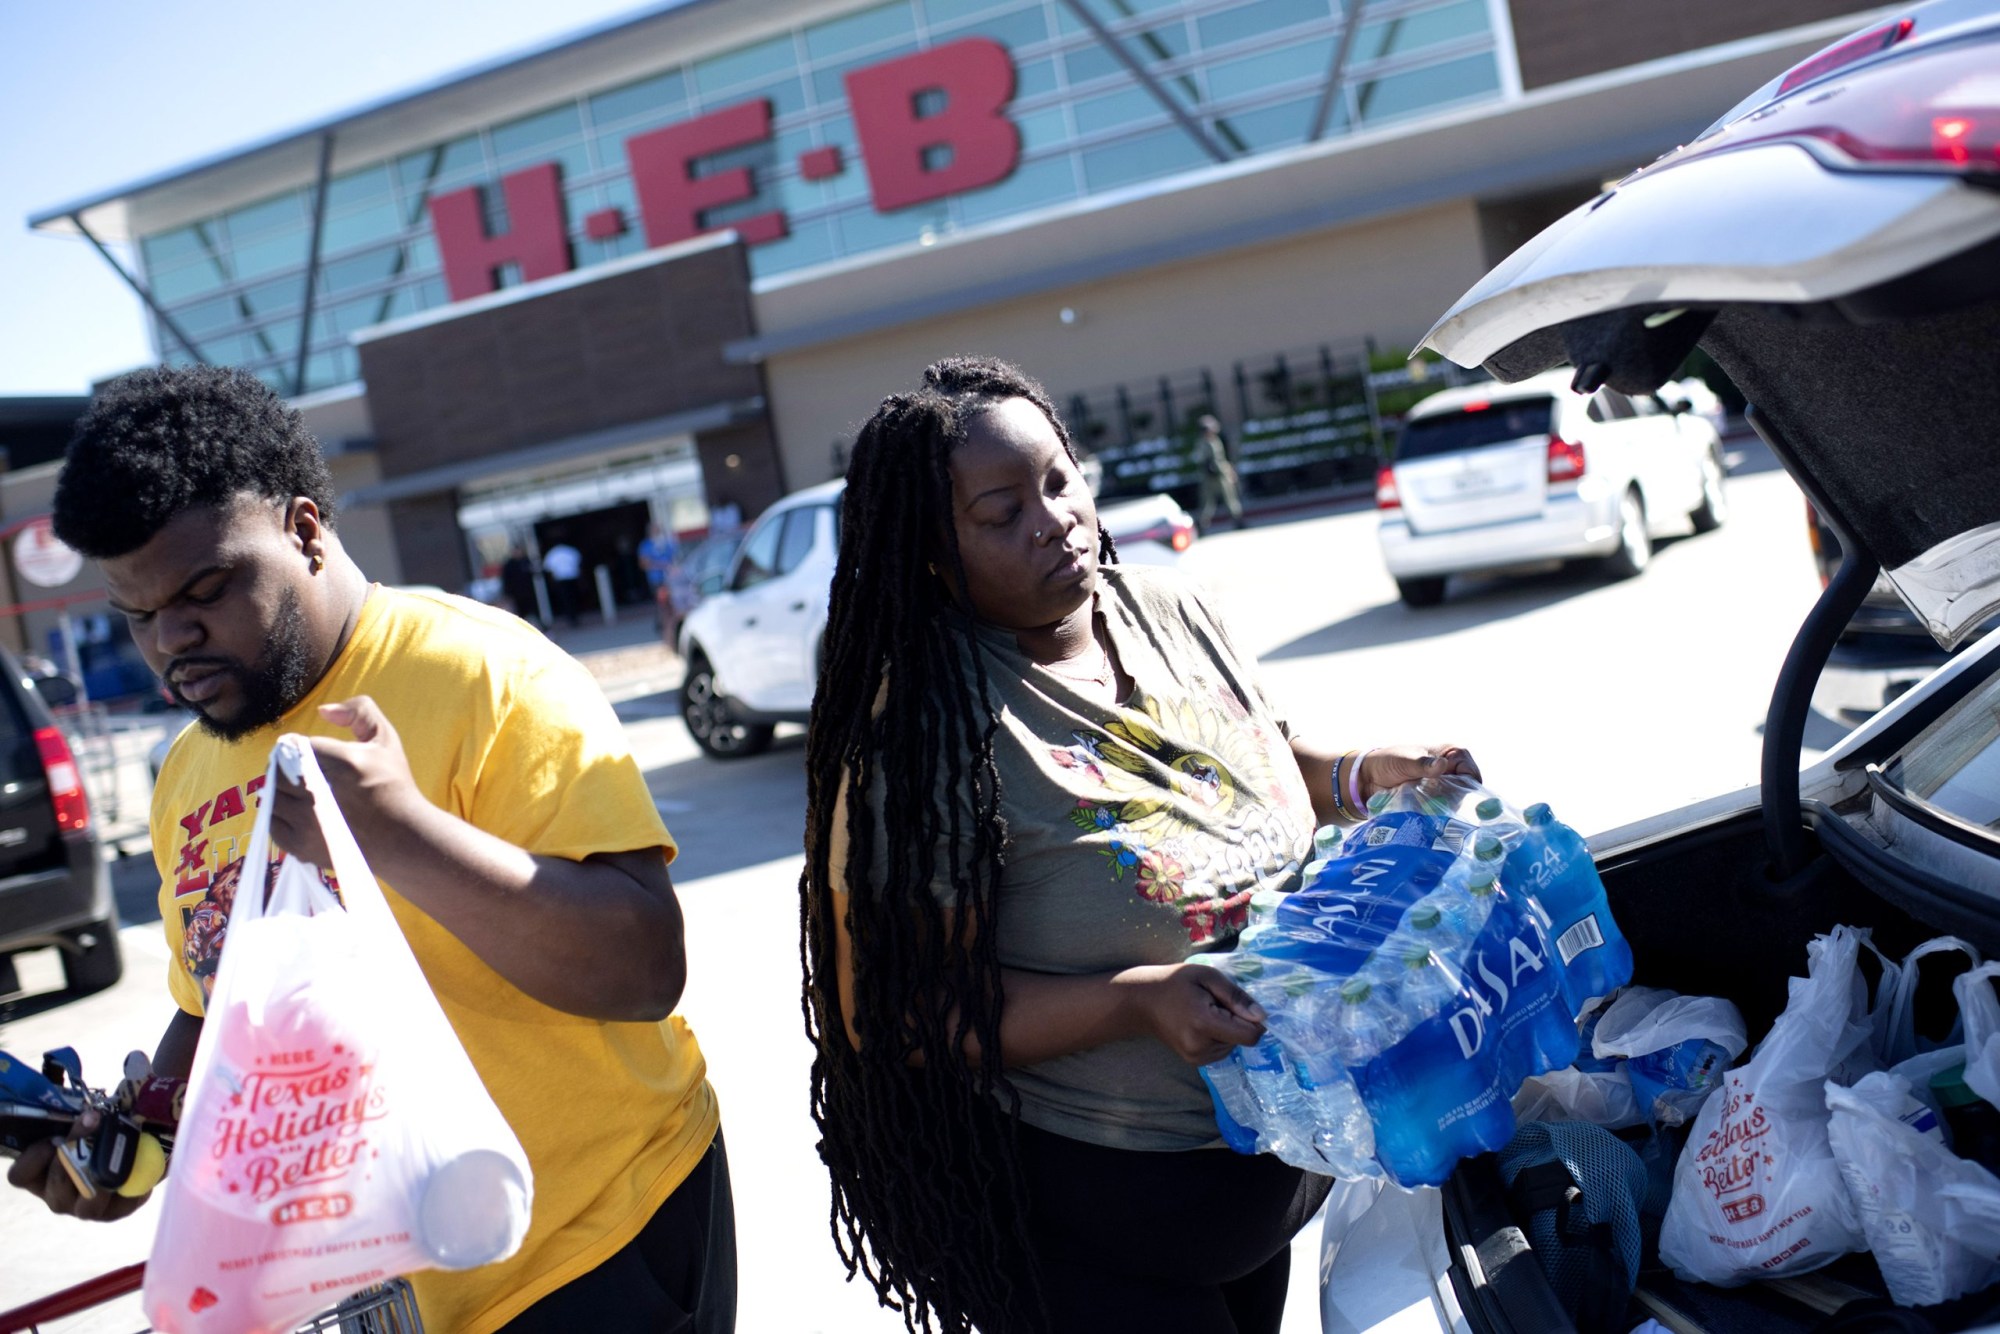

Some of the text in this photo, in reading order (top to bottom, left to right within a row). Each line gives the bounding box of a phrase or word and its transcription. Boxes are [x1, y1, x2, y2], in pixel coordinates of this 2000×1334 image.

[1529, 845, 1561, 883] 24
[1540, 861, 1569, 889] BOTTLES
[243, 1060, 351, 1114] Texas
[212, 1086, 389, 1160] Holidays
[246, 1137, 368, 1202] Better
[1703, 1151, 1760, 1199] Better
[1779, 1215, 1794, 1230] NEW
[1794, 1206, 1814, 1220] YEAR
